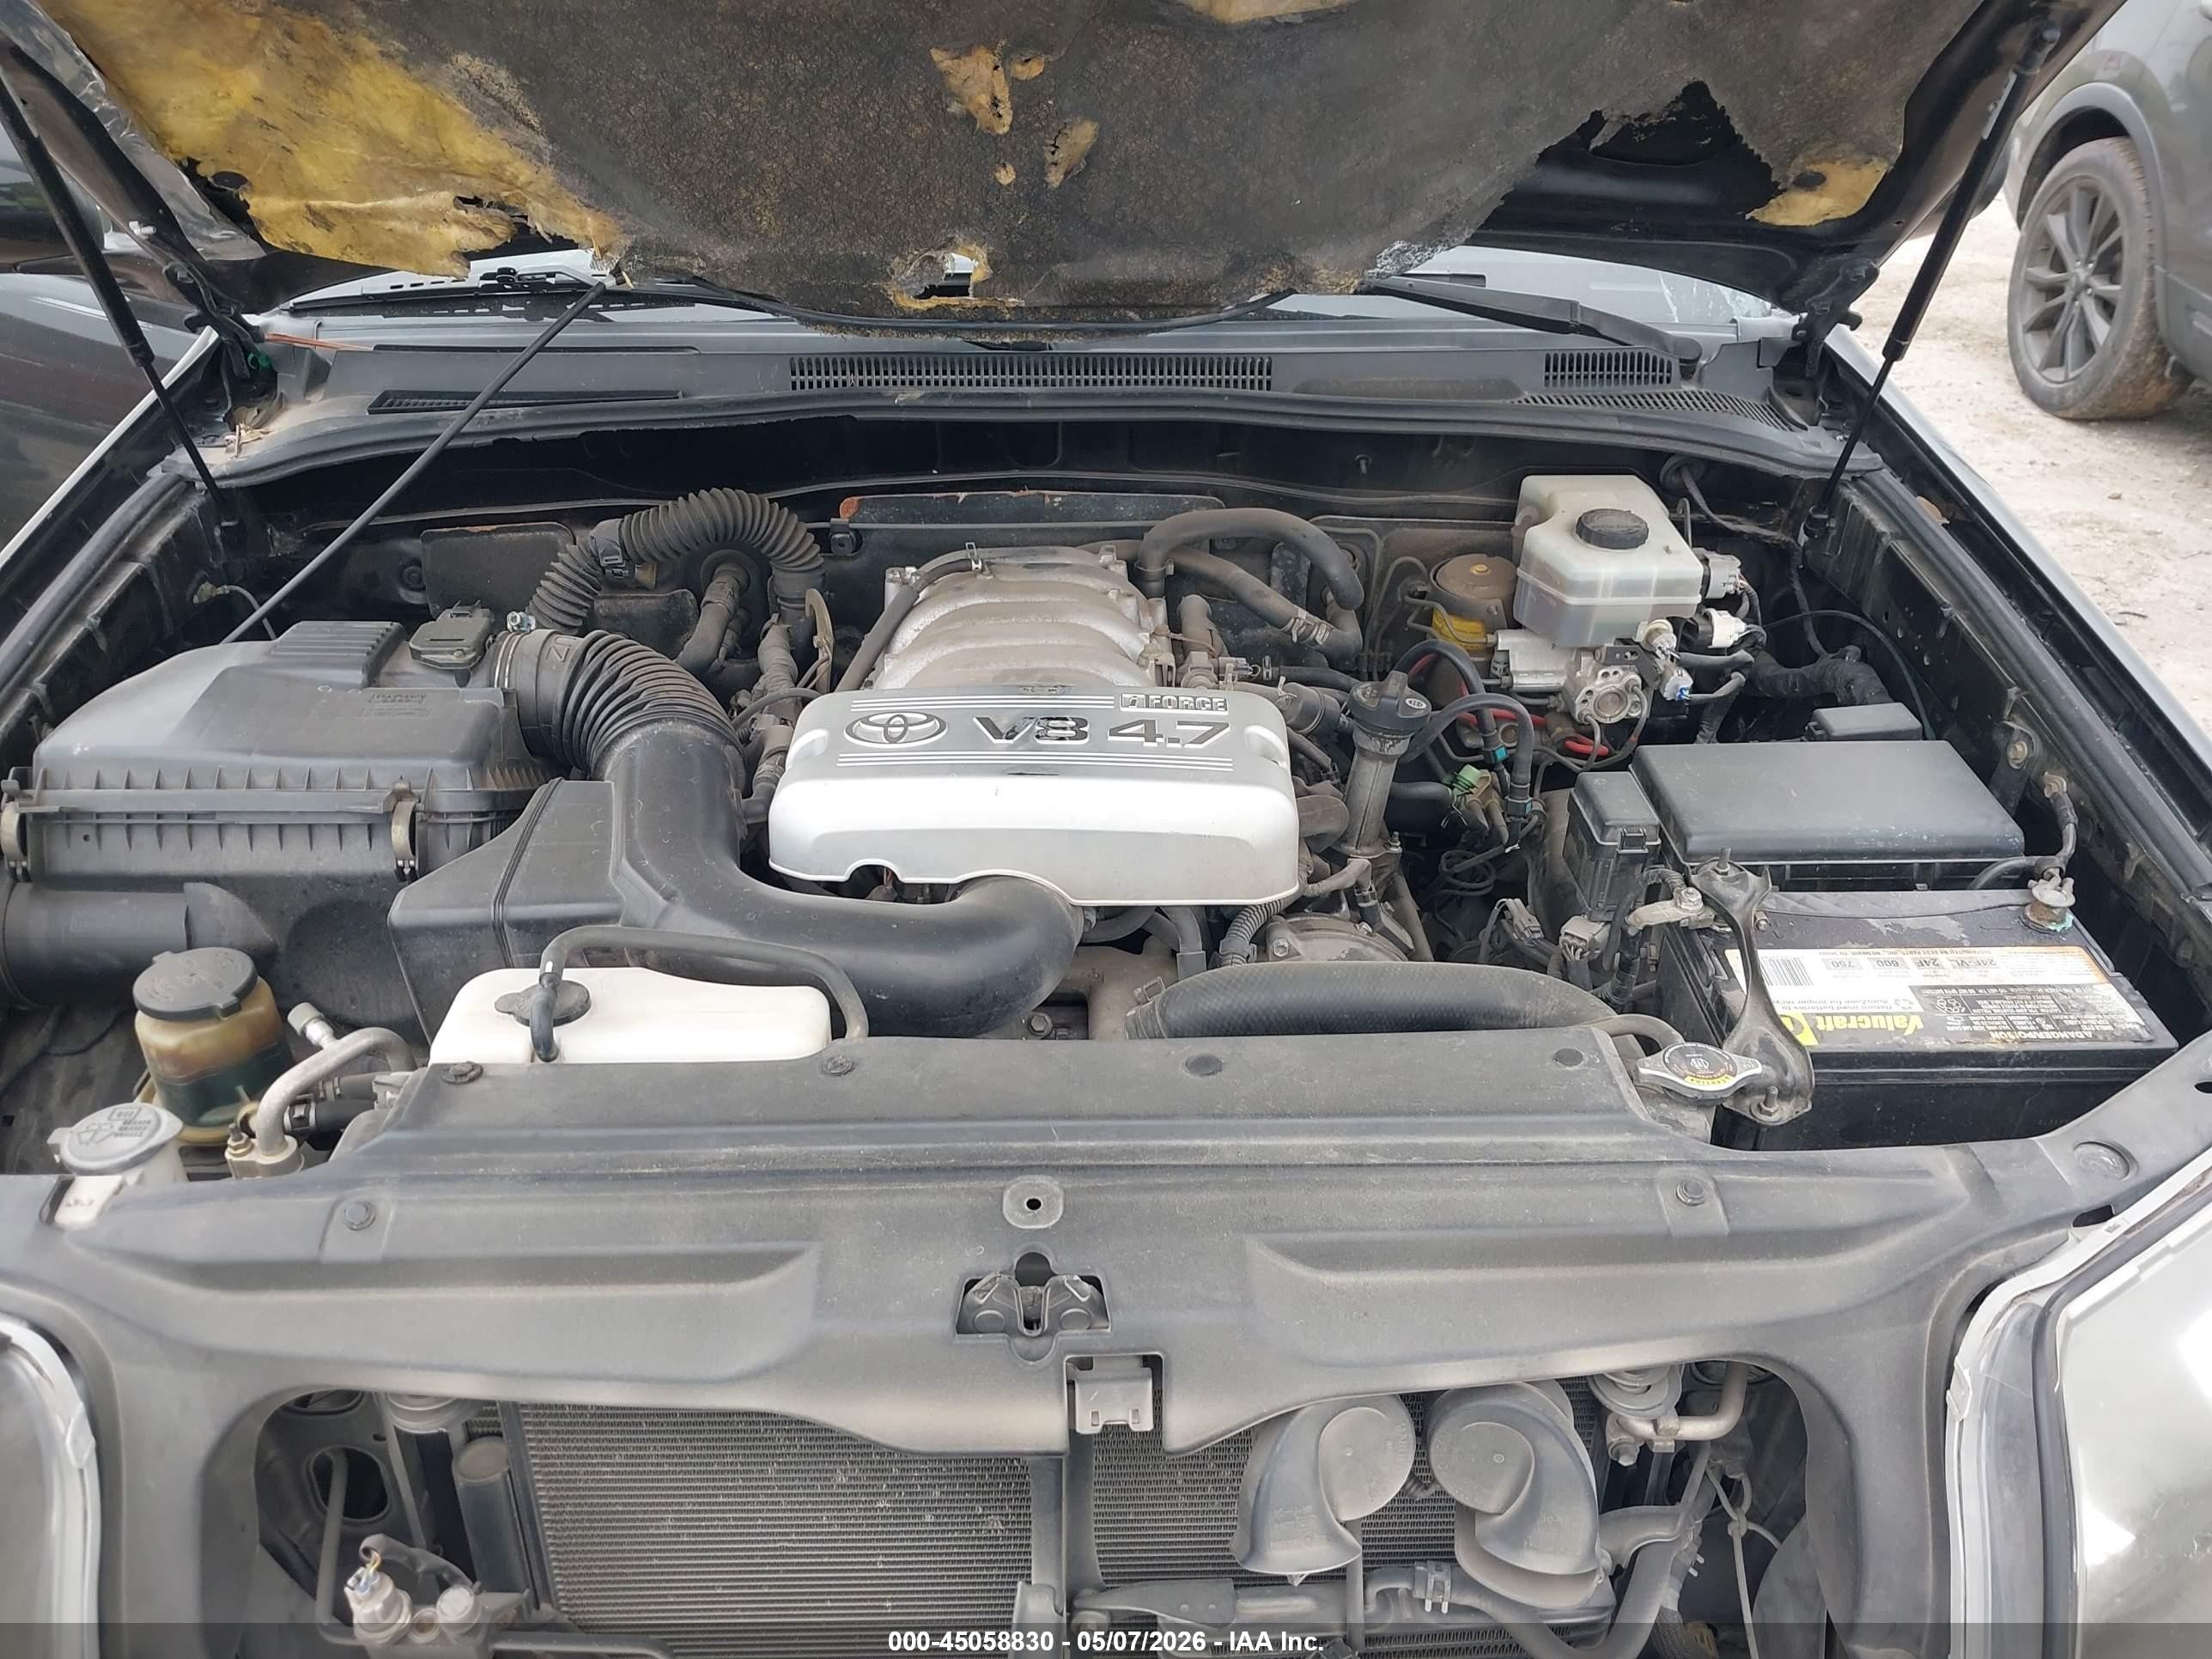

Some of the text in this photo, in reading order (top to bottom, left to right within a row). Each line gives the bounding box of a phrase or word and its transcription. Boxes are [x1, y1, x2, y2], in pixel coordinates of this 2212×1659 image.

[973, 716, 1232, 749] V8 4.7
[1831, 960, 1855, 969] 750
[1875, 959, 1899, 968] 600
[1916, 958, 1939, 967] 24F
[1816, 1015, 1924, 1036] Valucraft
